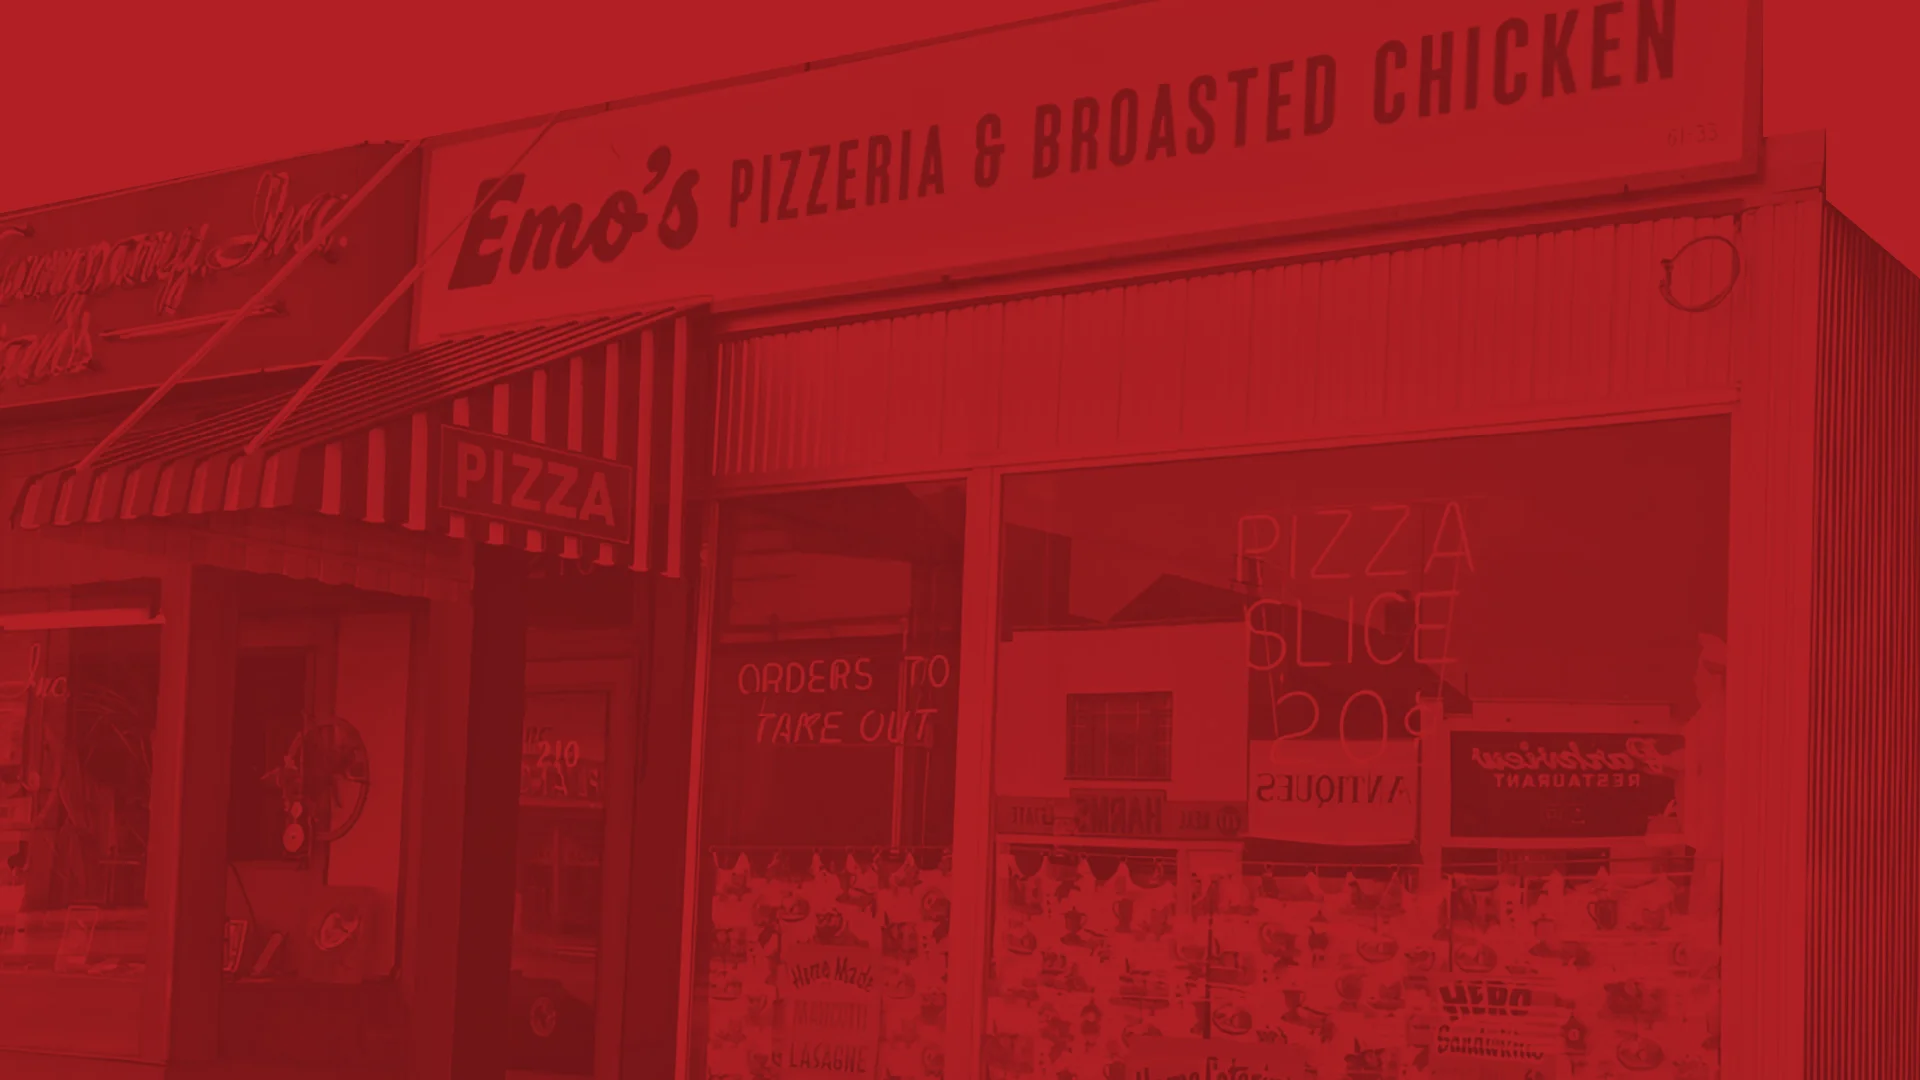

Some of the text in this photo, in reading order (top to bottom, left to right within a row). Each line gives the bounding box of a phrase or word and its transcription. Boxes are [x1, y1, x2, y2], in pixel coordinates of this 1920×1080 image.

[447, 0, 1679, 290] Emo's PIZZERIA & BROASTED CHICKEN
[456, 440, 616, 527] PIZZA
[1236, 501, 1475, 582] PIZZA
[1246, 591, 1461, 671] SLICE
[738, 654, 951, 694] ORDERS TO
[756, 708, 939, 744] TAKE OUT
[536, 740, 580, 768] 210
[834, 956, 874, 992] Made
[1439, 980, 1532, 1021] HERO
[789, 1041, 870, 1073] LASAGNE
